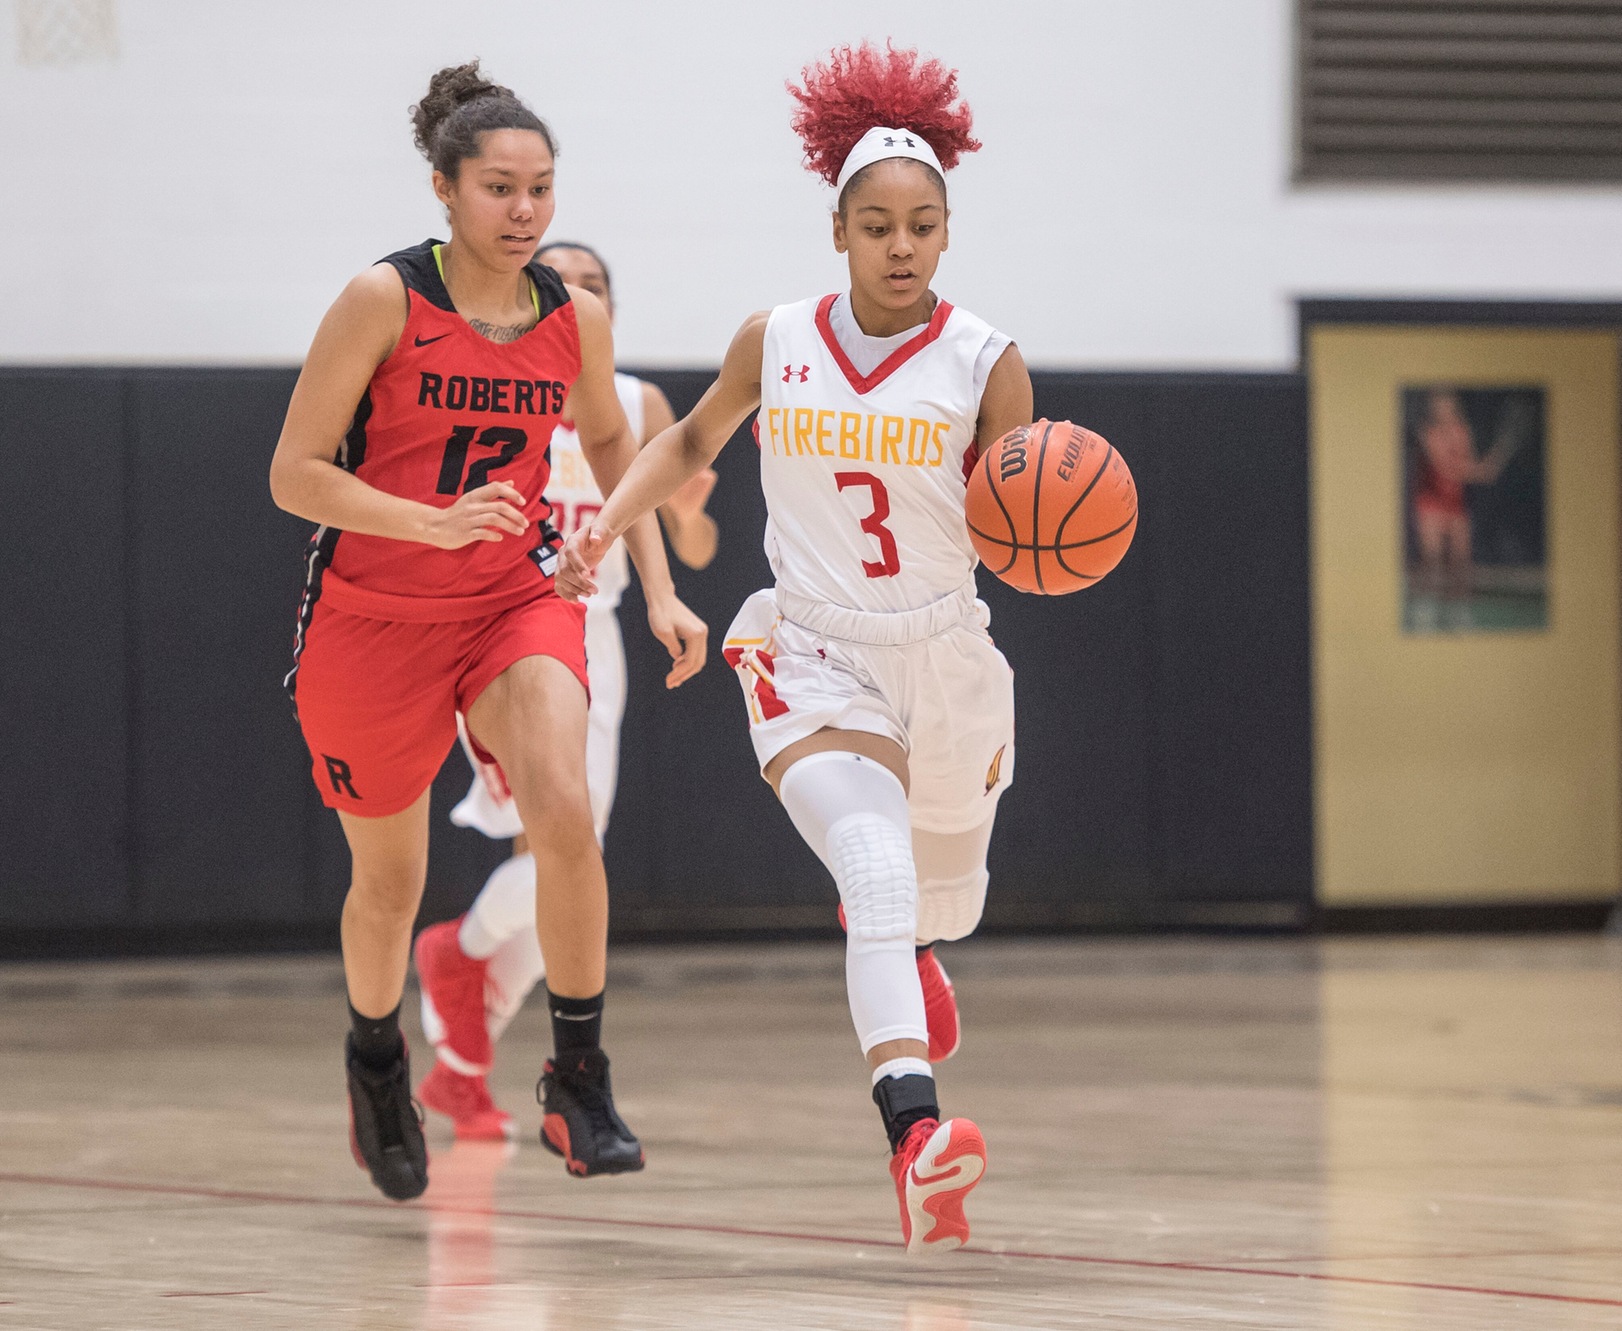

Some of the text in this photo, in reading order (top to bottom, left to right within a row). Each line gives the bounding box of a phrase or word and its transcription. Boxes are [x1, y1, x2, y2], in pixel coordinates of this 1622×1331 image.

[418, 371, 565, 415] ROBERTS
[436, 425, 528, 498] 12
[768, 407, 951, 467] FIREBIRDS
[834, 471, 901, 578] 3
[537, 546, 551, 559] M
[321, 753, 363, 800] R
